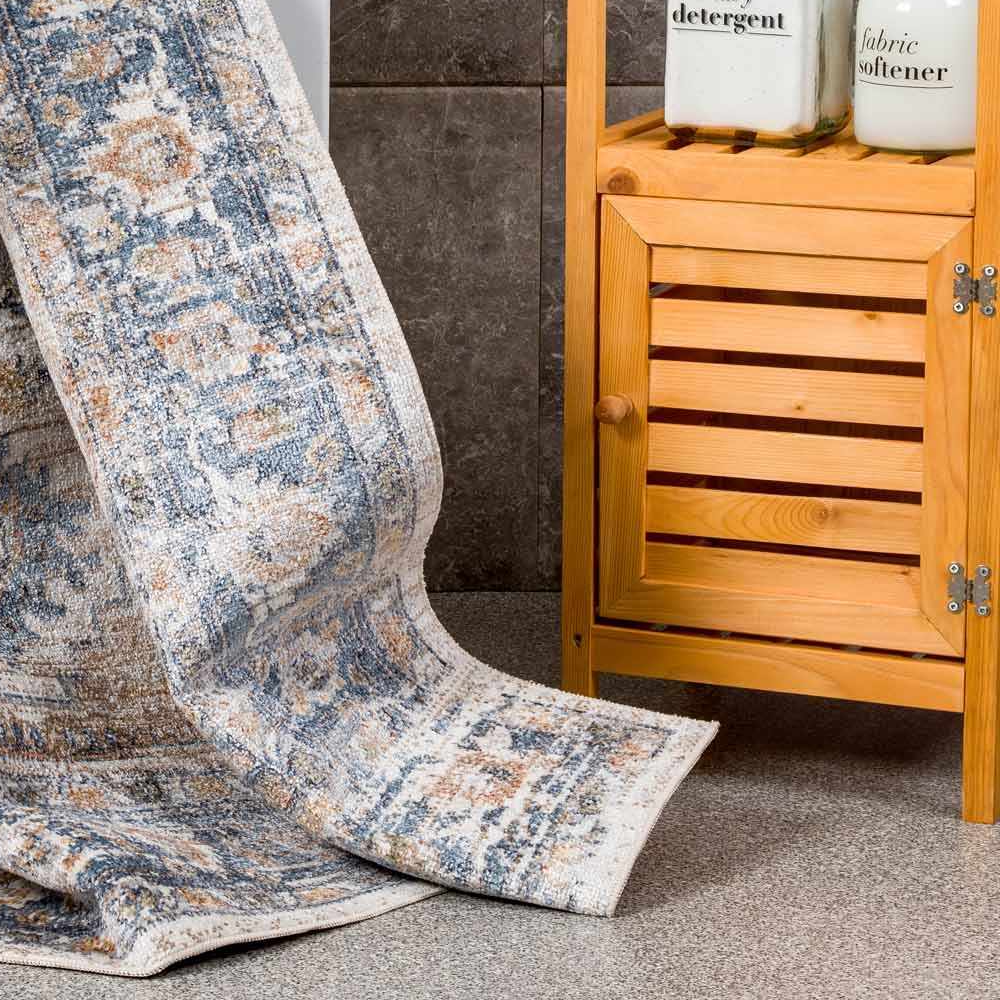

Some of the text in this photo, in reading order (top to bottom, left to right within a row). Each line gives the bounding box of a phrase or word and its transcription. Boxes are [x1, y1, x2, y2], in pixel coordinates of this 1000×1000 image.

[672, 3, 785, 34] detergent
[859, 27, 919, 55] fabric
[858, 56, 948, 82] softener
